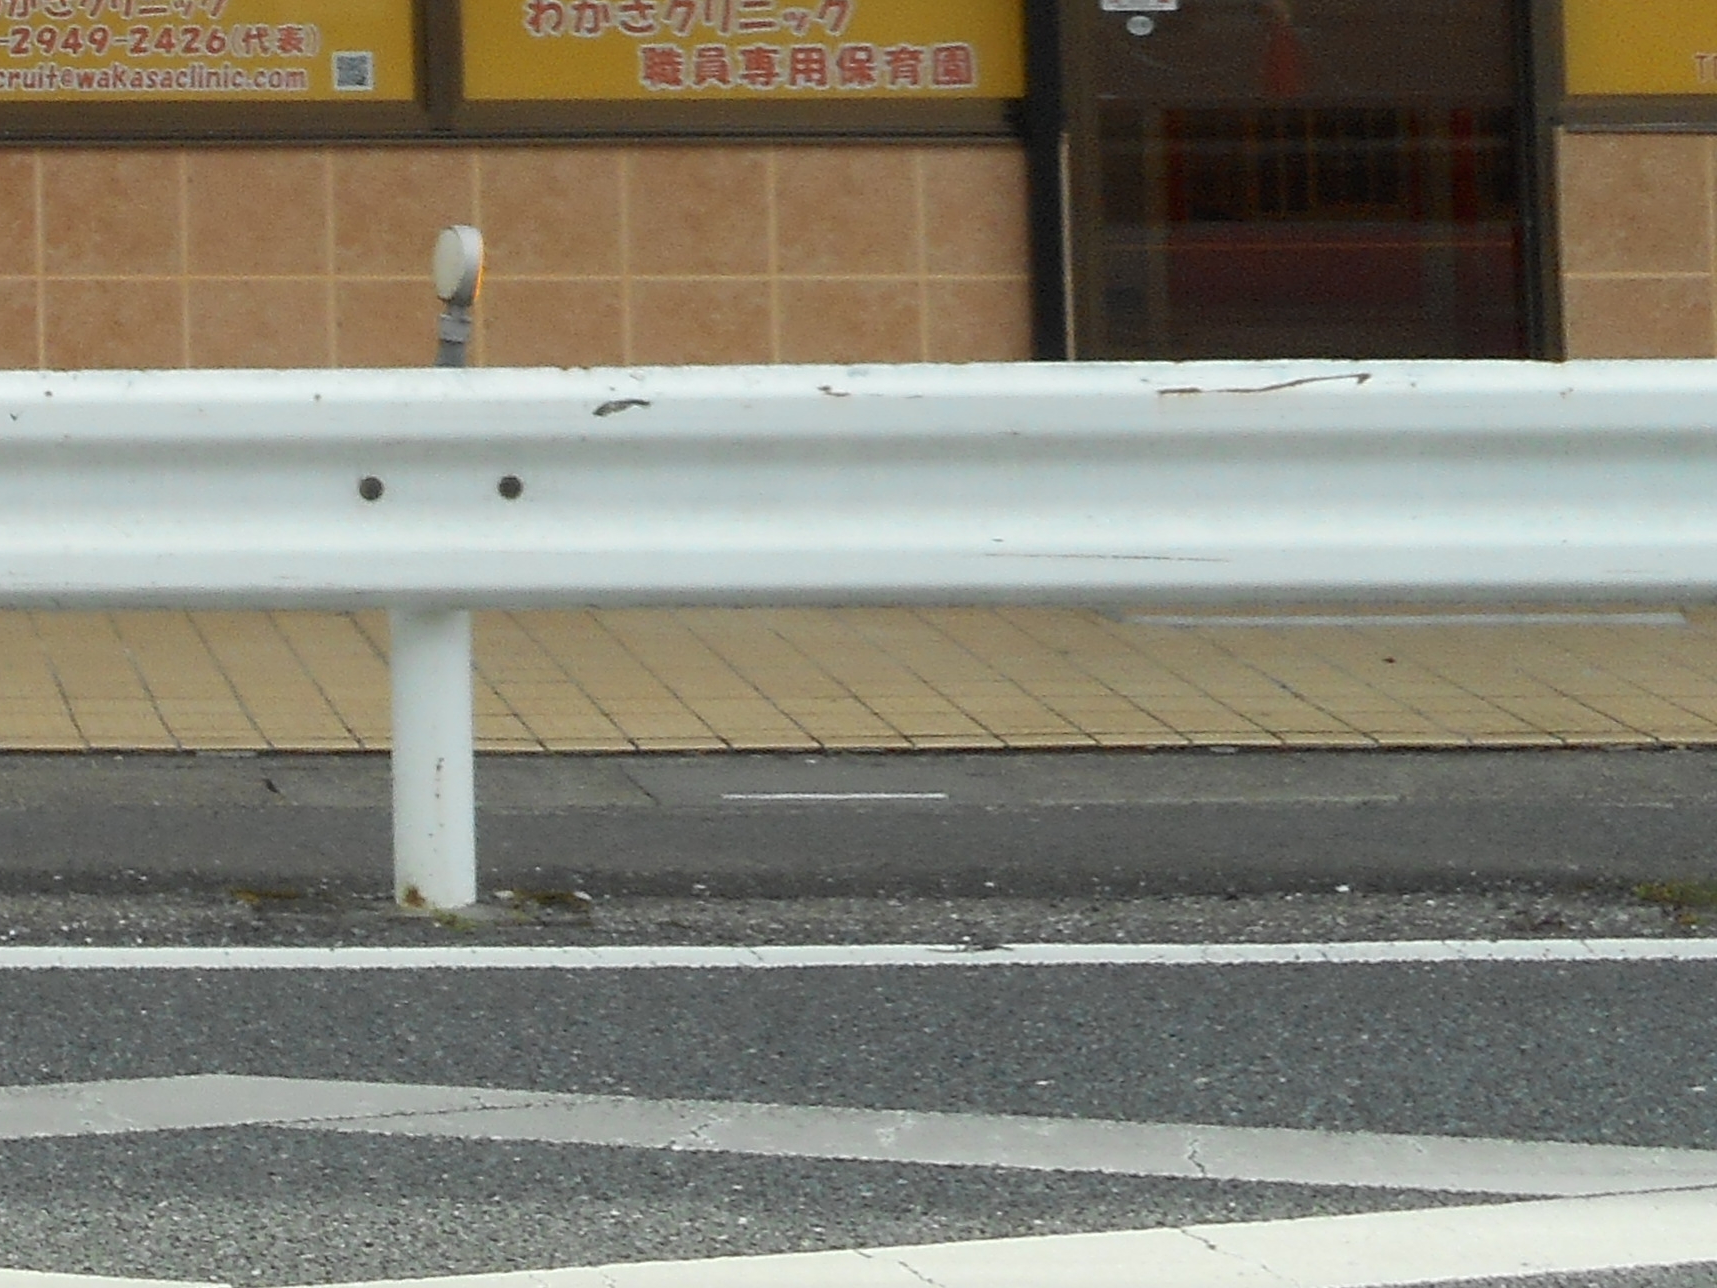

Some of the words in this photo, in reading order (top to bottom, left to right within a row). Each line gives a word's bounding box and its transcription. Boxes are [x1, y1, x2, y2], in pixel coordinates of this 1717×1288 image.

[639, 41, 979, 91] 職員専用保育園
